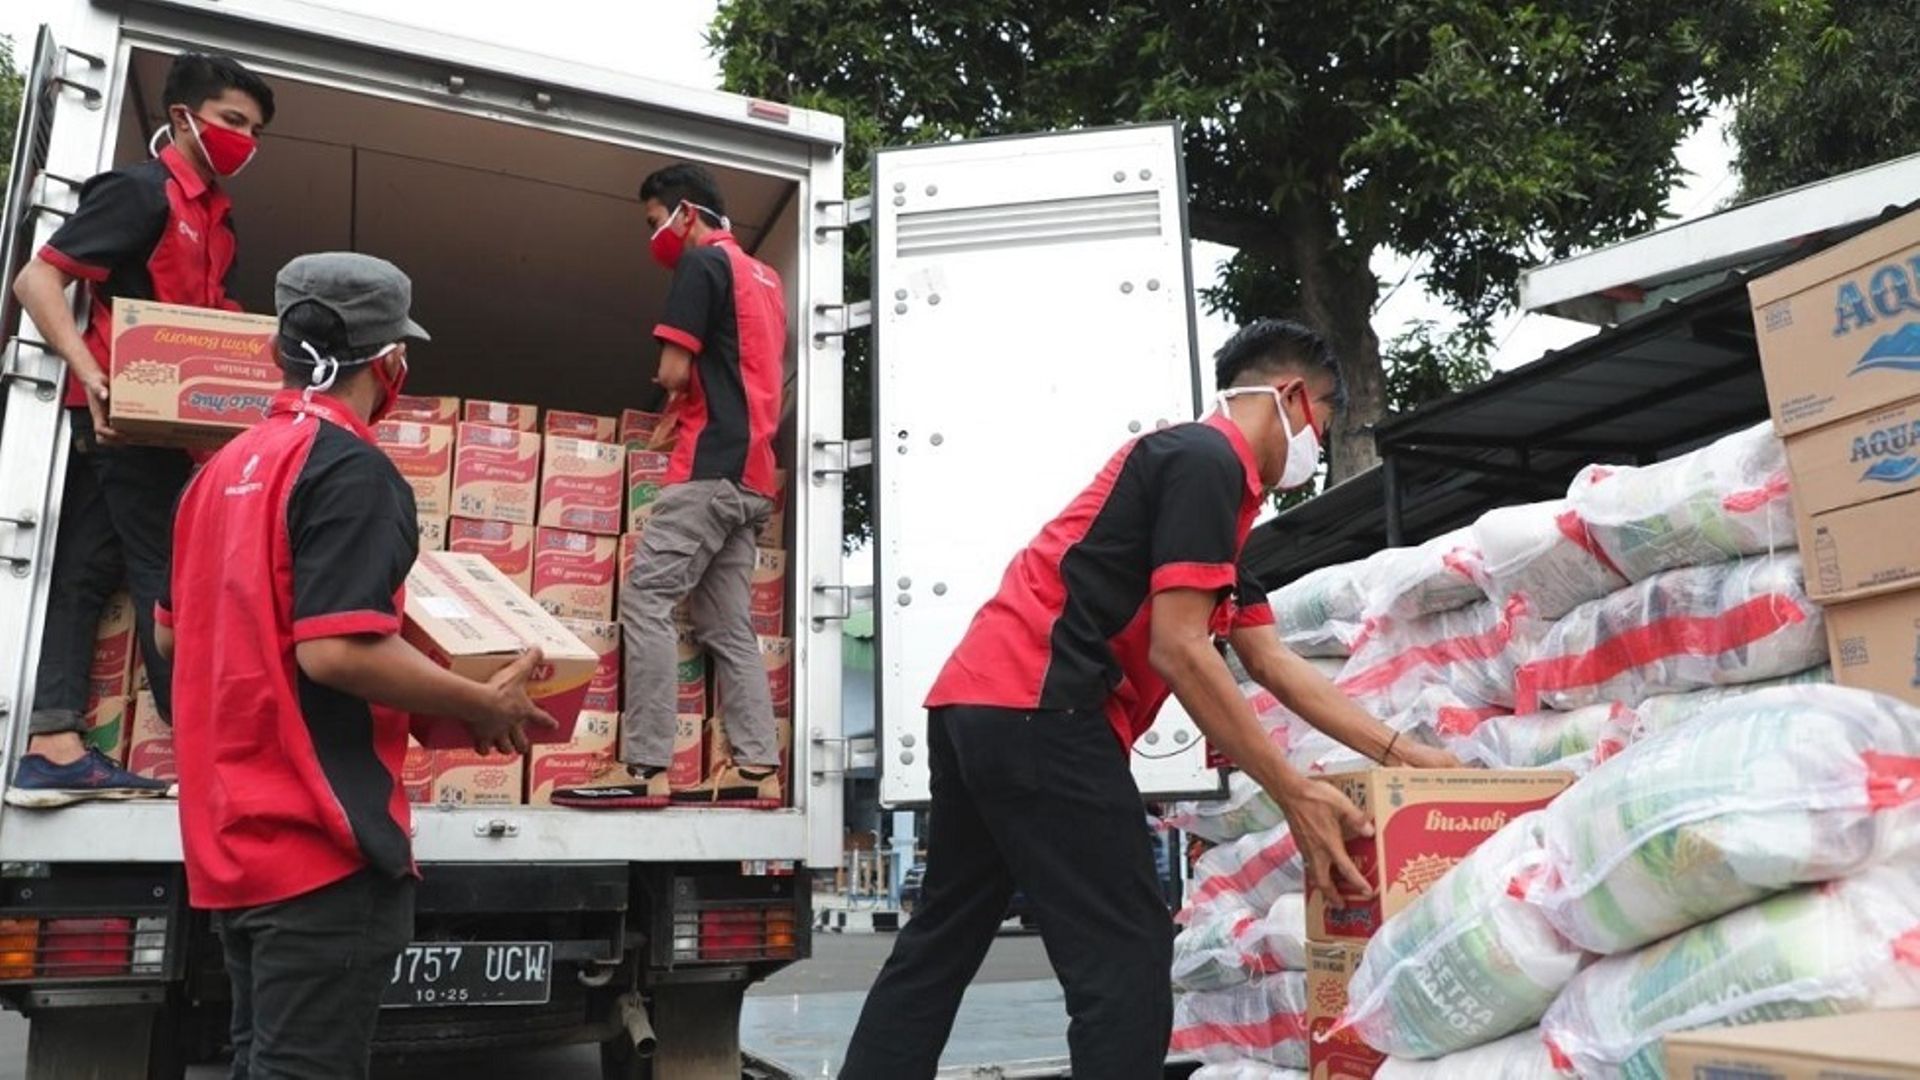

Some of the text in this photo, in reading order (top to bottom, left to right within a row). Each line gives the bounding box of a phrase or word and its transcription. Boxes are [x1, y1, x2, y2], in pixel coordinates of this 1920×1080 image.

[153, 328, 219, 353] Bawang
[1425, 809, 1507, 833] goreng
[485, 946, 546, 982] UCW
[1430, 951, 1495, 1025] SETRA
